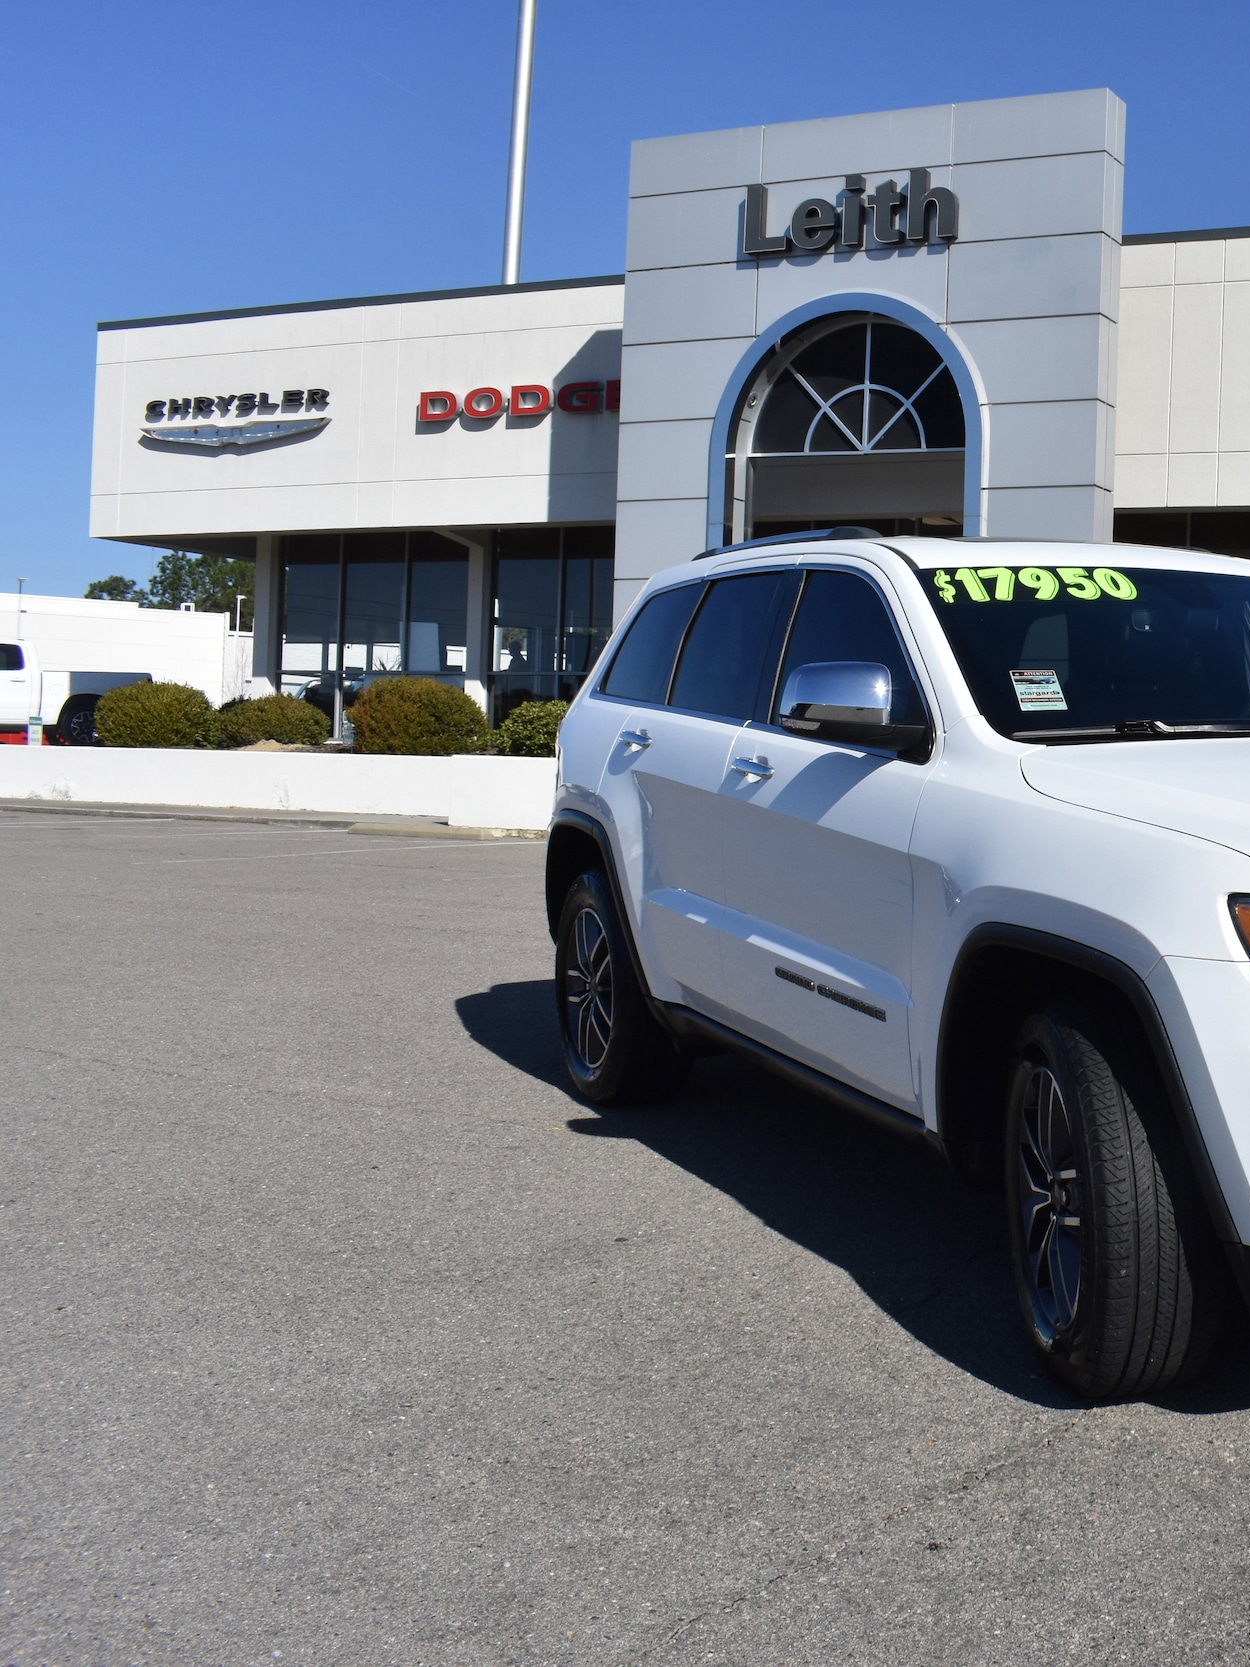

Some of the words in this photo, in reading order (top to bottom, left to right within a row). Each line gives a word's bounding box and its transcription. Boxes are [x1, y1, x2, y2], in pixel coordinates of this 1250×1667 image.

[743, 168, 959, 255] Leith
[145, 388, 331, 417] CHRYSLER
[934, 566, 1138, 603] $17950
